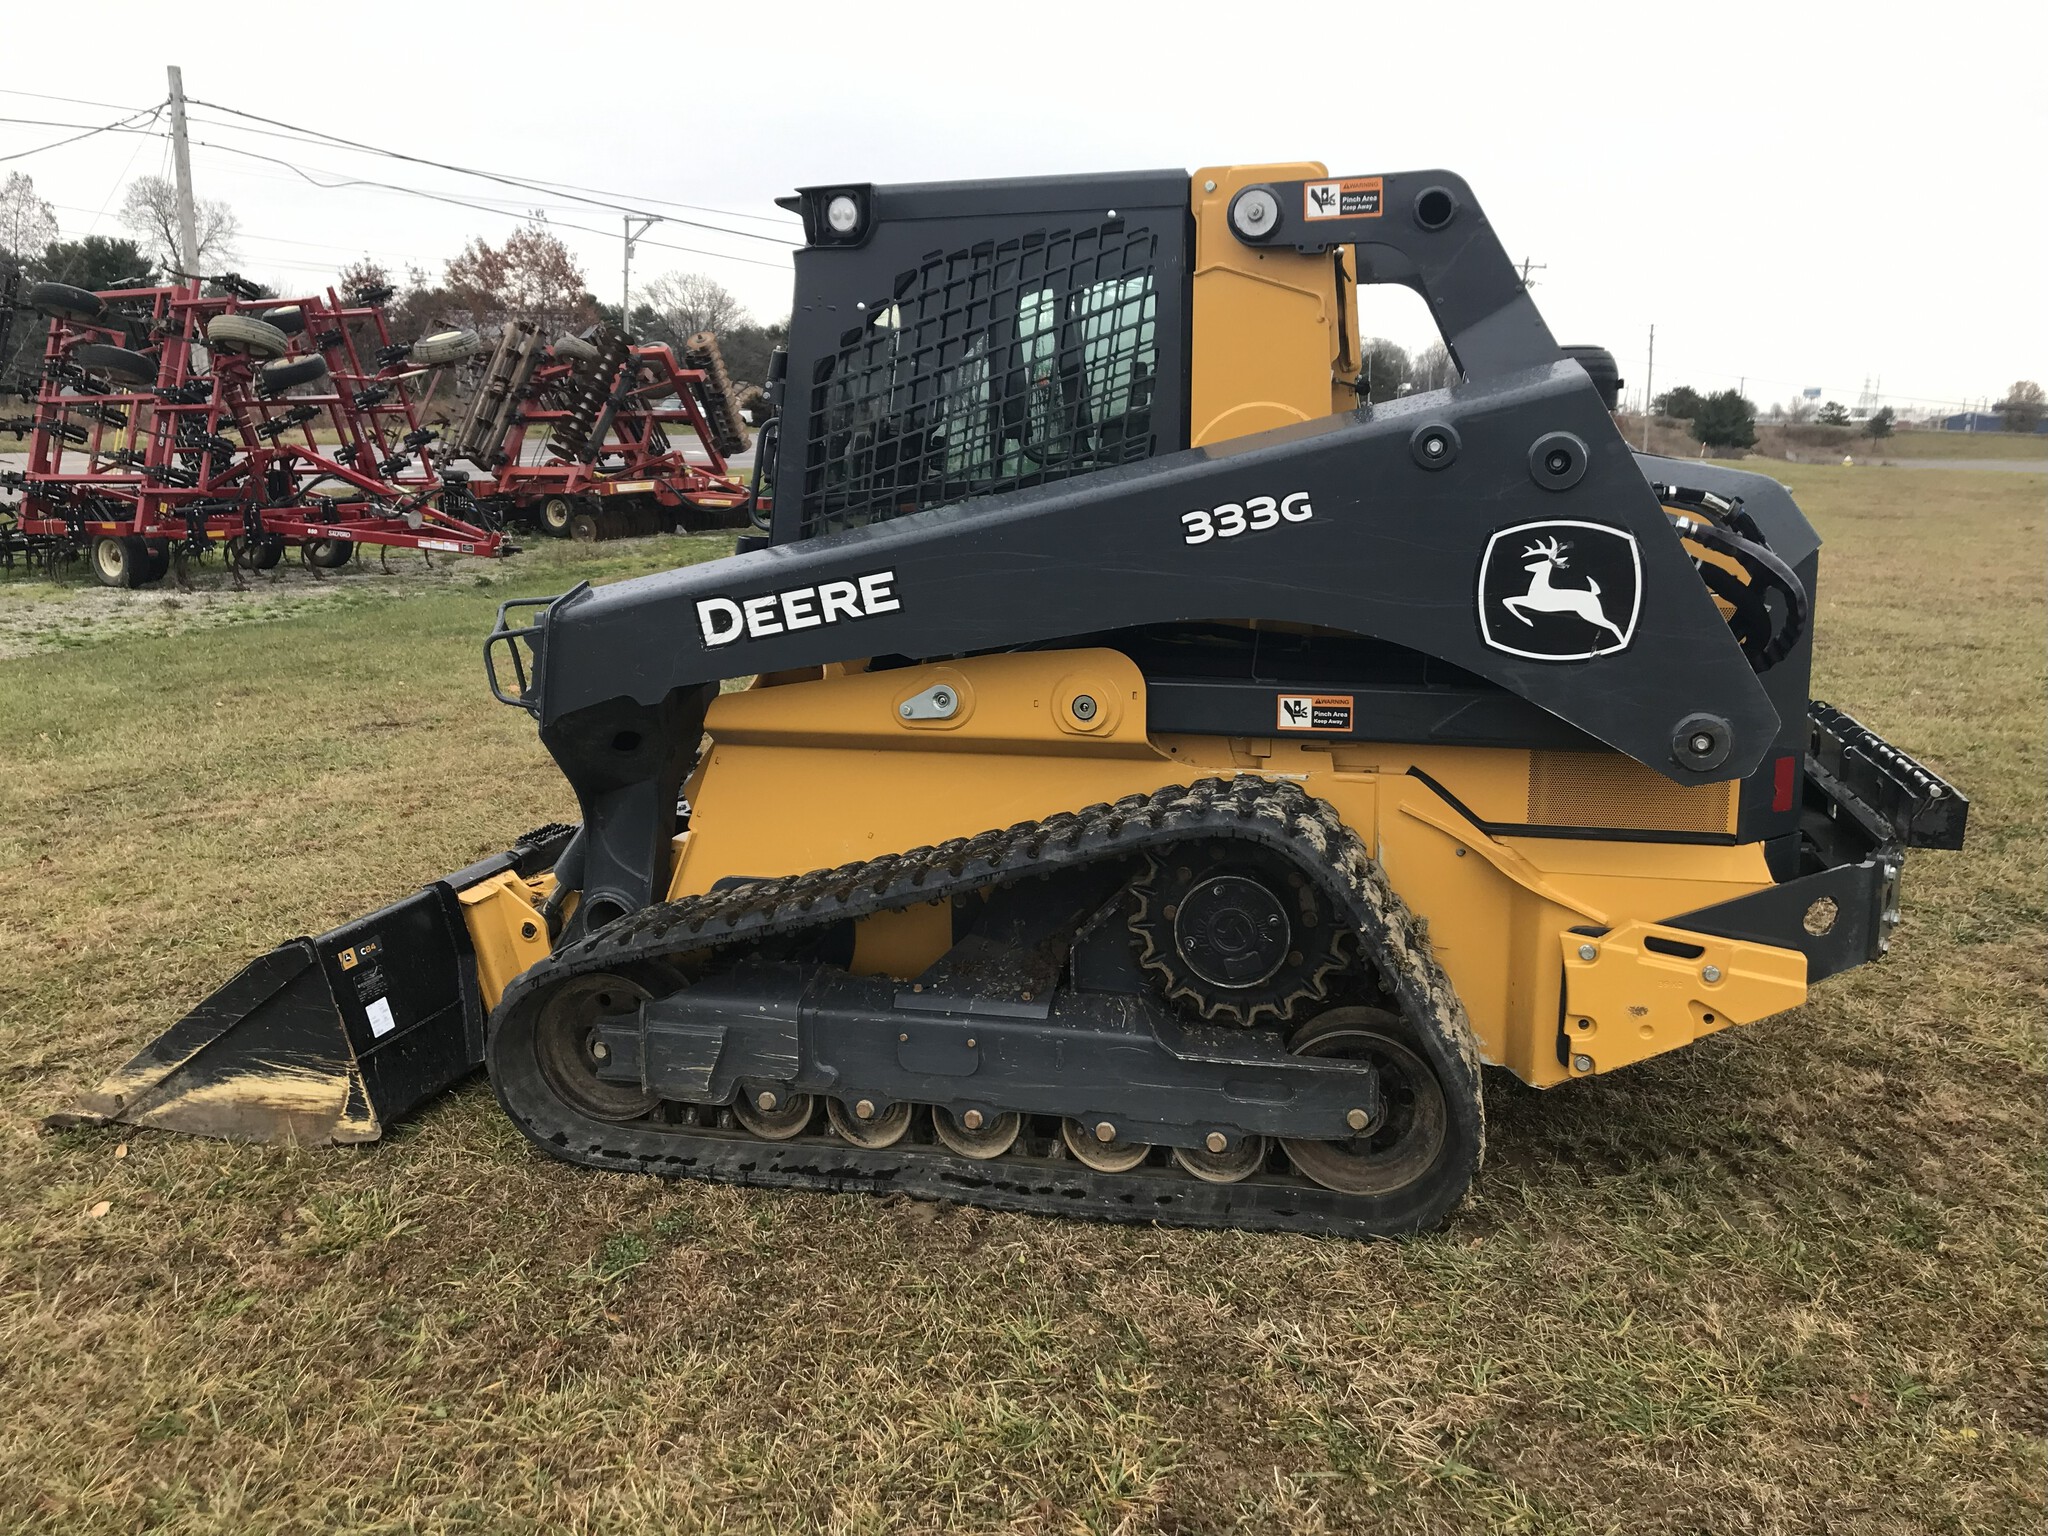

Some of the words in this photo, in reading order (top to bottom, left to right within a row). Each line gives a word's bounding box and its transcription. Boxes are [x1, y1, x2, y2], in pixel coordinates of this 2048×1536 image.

[1349, 181, 1379, 189] WARNING
[1342, 196, 1361, 204] Pinch
[1181, 491, 1314, 545] 333G
[696, 571, 901, 647] DEERE
[360, 942, 377, 956] C84
